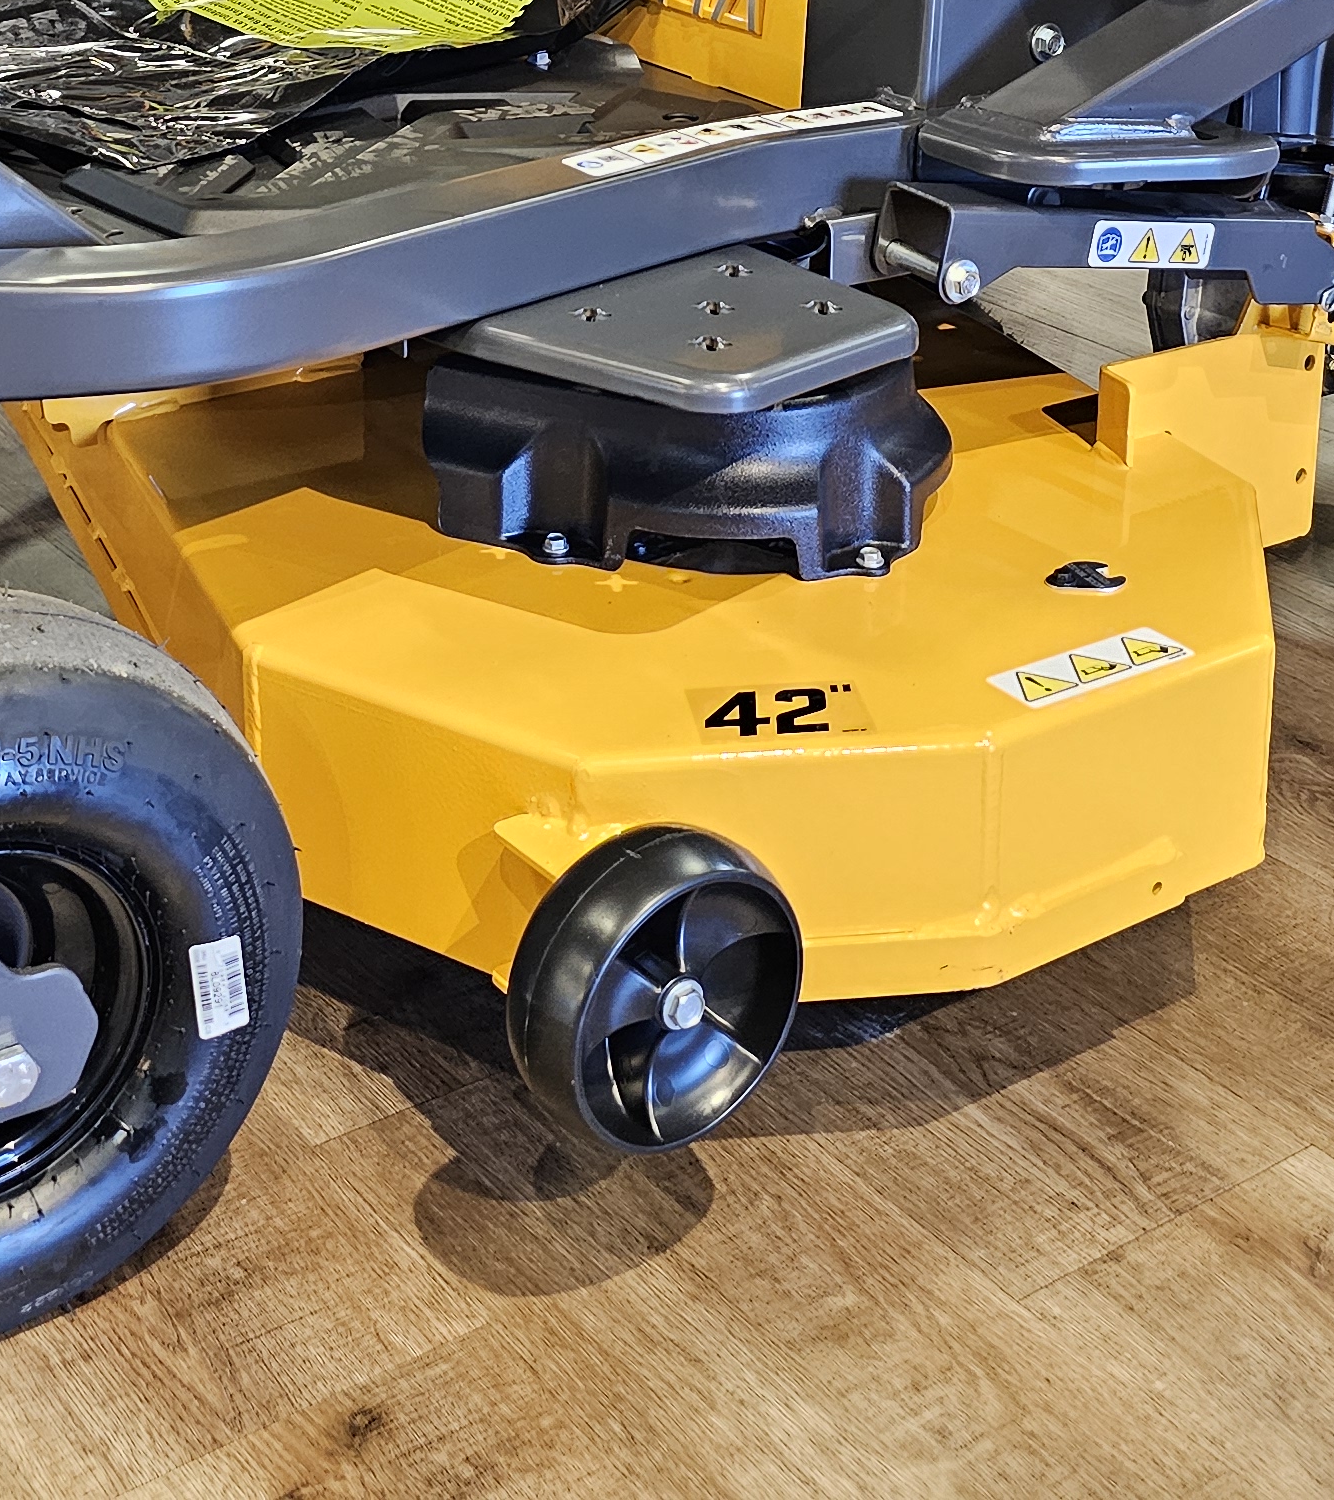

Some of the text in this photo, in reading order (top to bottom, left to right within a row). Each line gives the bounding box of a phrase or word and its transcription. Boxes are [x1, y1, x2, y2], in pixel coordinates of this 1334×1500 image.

[476, 1, 498, 15] Extreme
[704, 683, 851, 737] 42"
[47, 734, 126, 773] NHS
